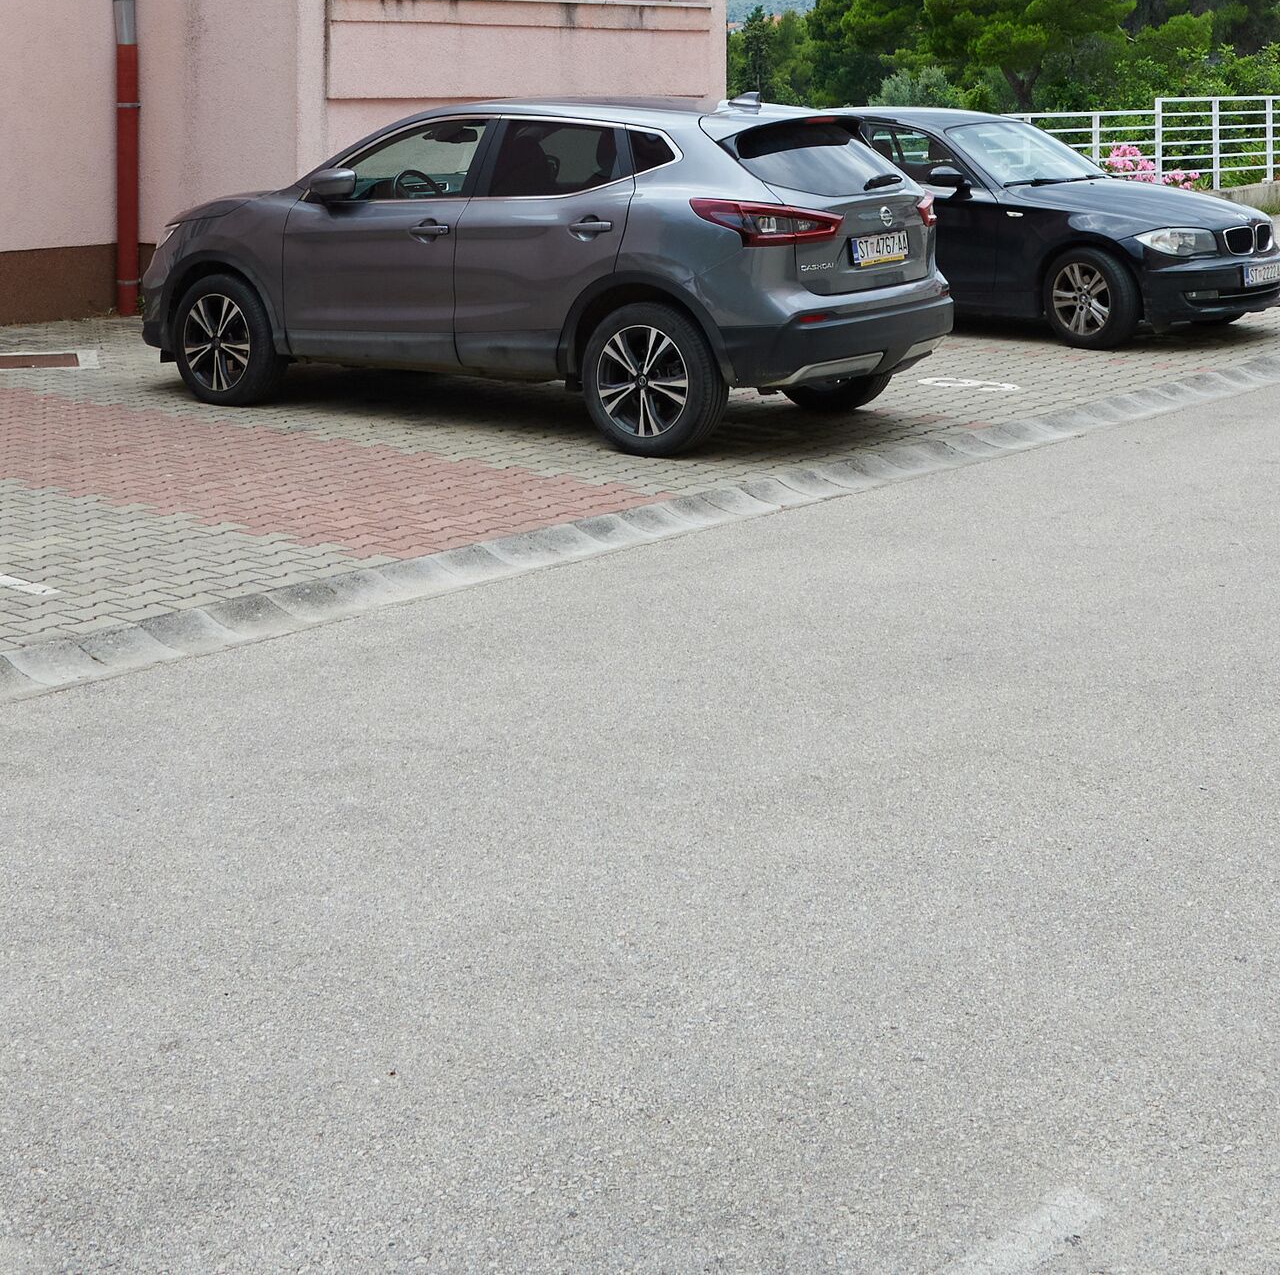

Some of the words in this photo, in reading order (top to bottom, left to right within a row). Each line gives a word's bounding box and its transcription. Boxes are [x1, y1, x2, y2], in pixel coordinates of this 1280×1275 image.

[858, 241, 869, 258] ST
[1250, 268, 1258, 282] ST
[917, 377, 1021, 391] 9
